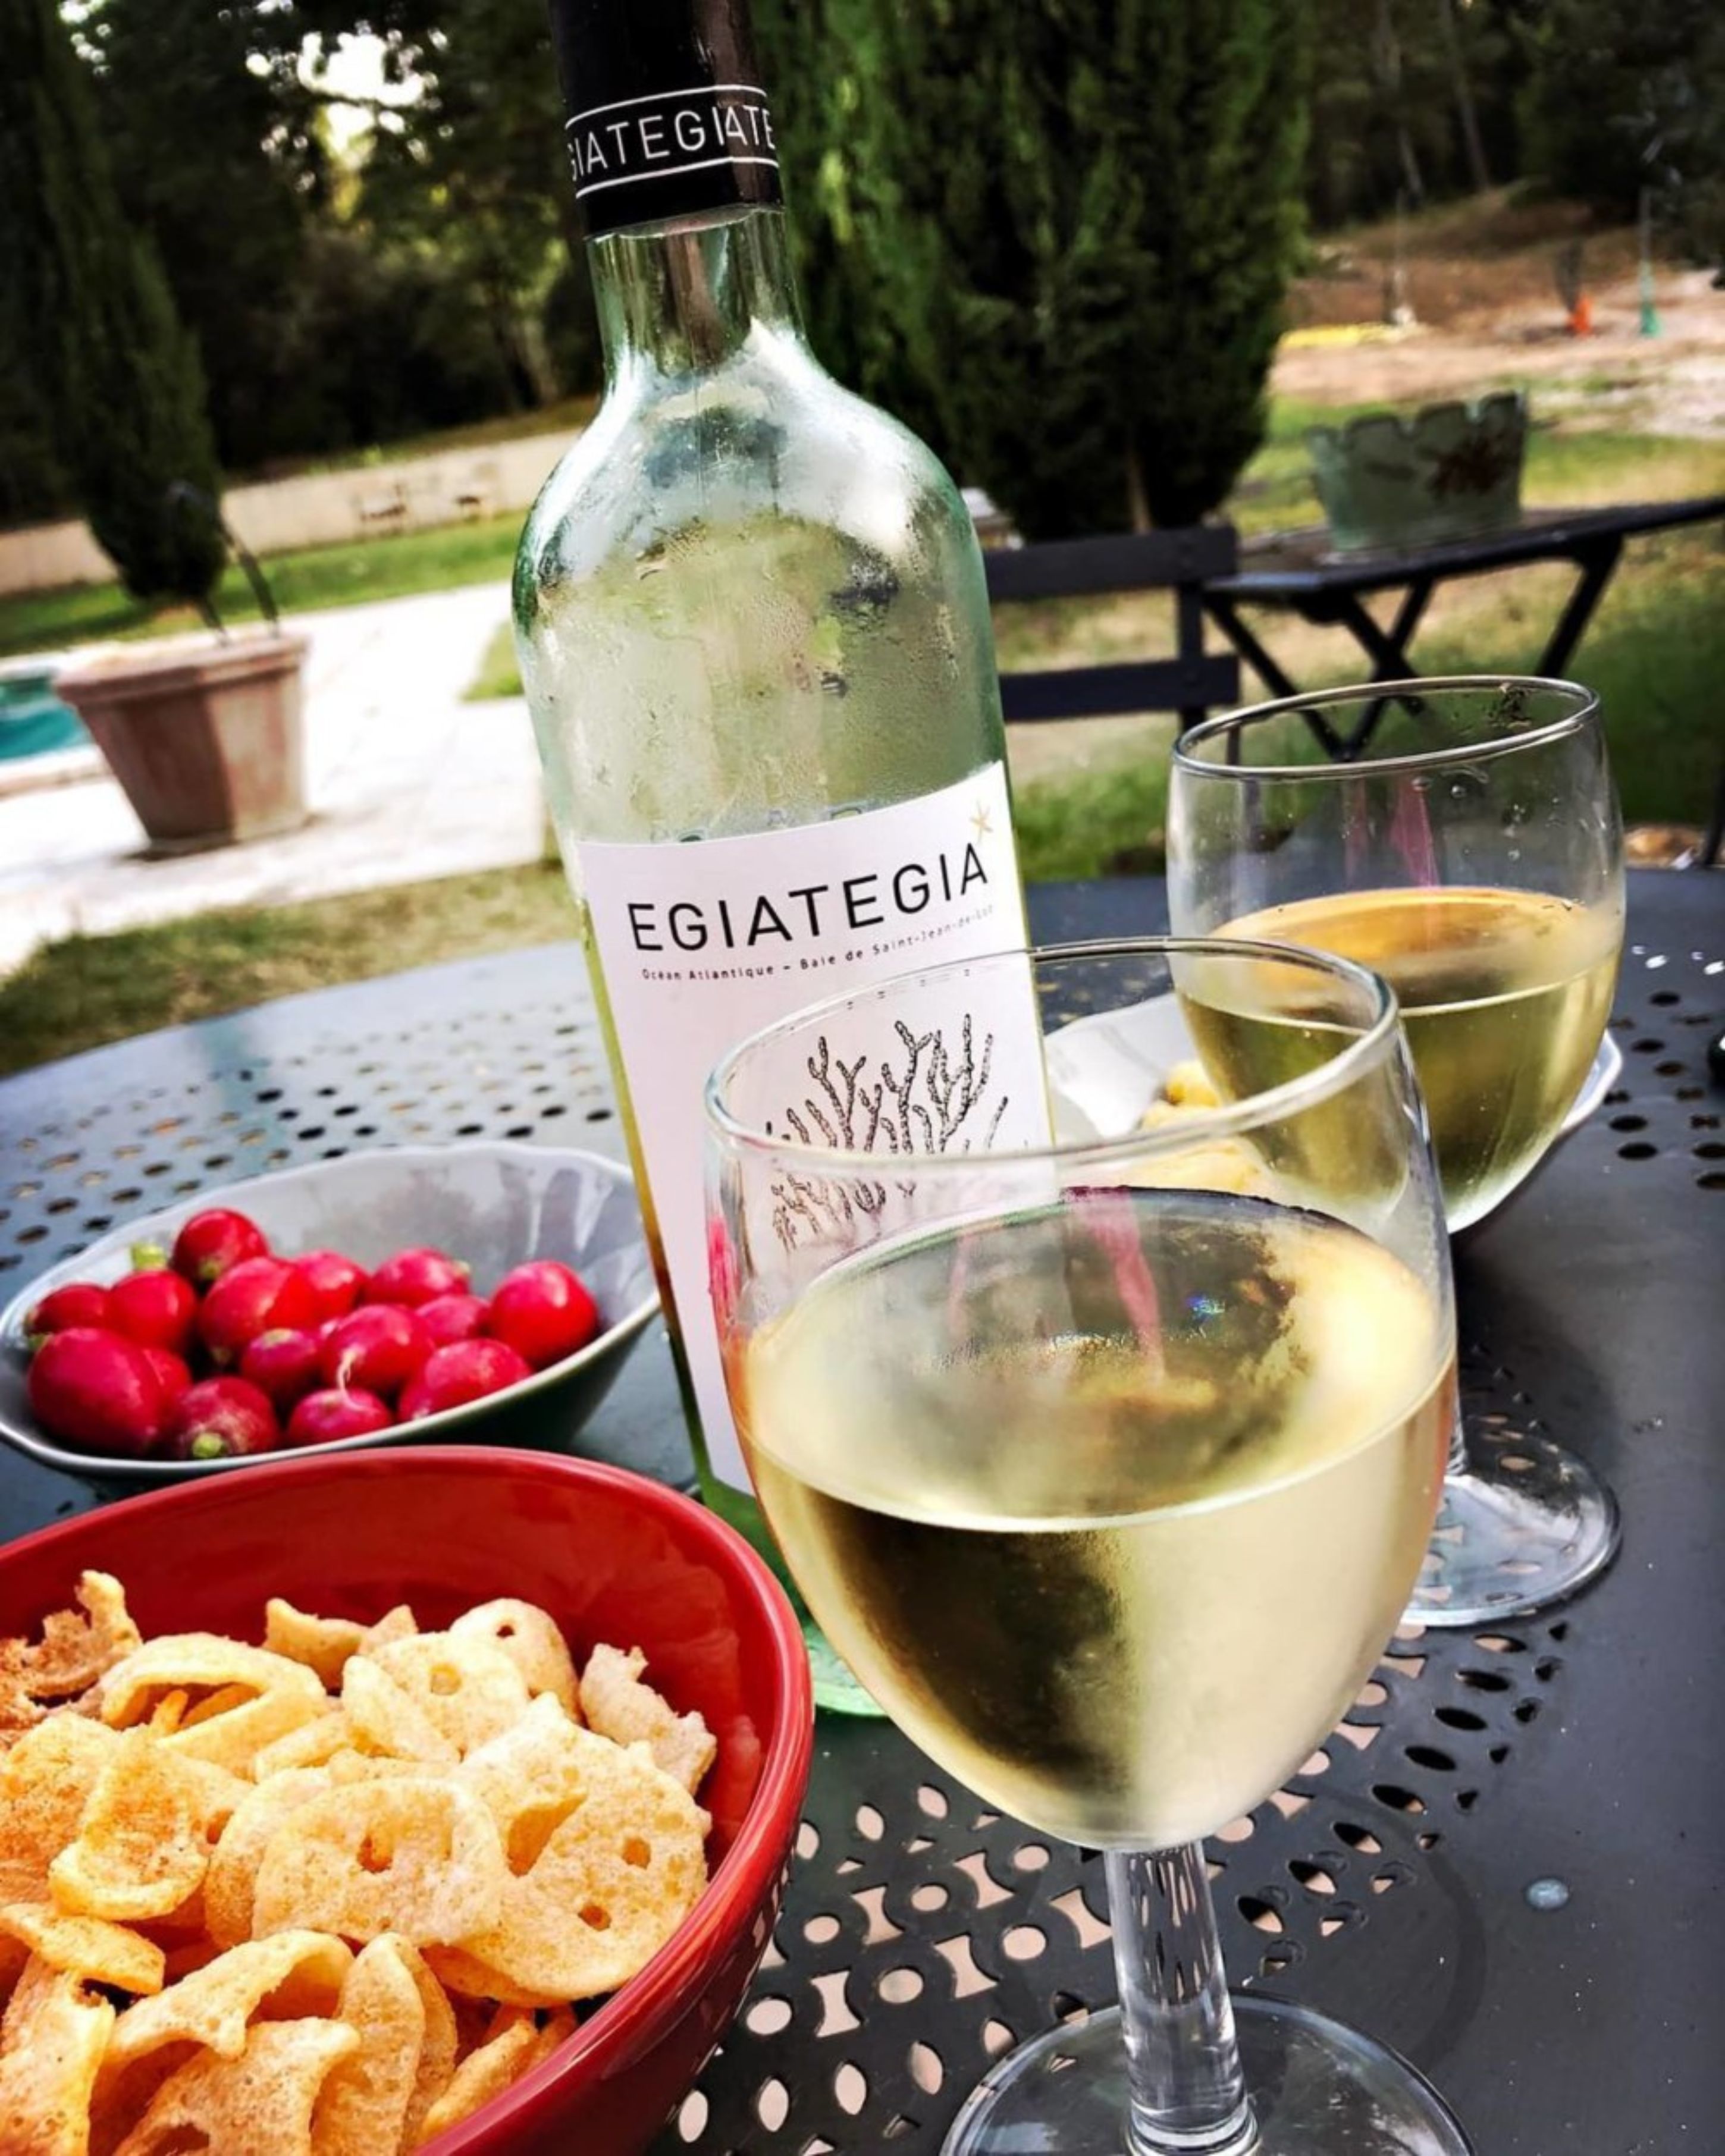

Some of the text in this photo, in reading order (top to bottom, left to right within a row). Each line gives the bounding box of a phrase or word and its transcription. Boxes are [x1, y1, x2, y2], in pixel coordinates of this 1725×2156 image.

[627, 843, 988, 950] EGIATEGIA
[689, 966, 774, 980] Atlantique
[800, 956, 835, 969] Baie
[845, 950, 863, 962] de
